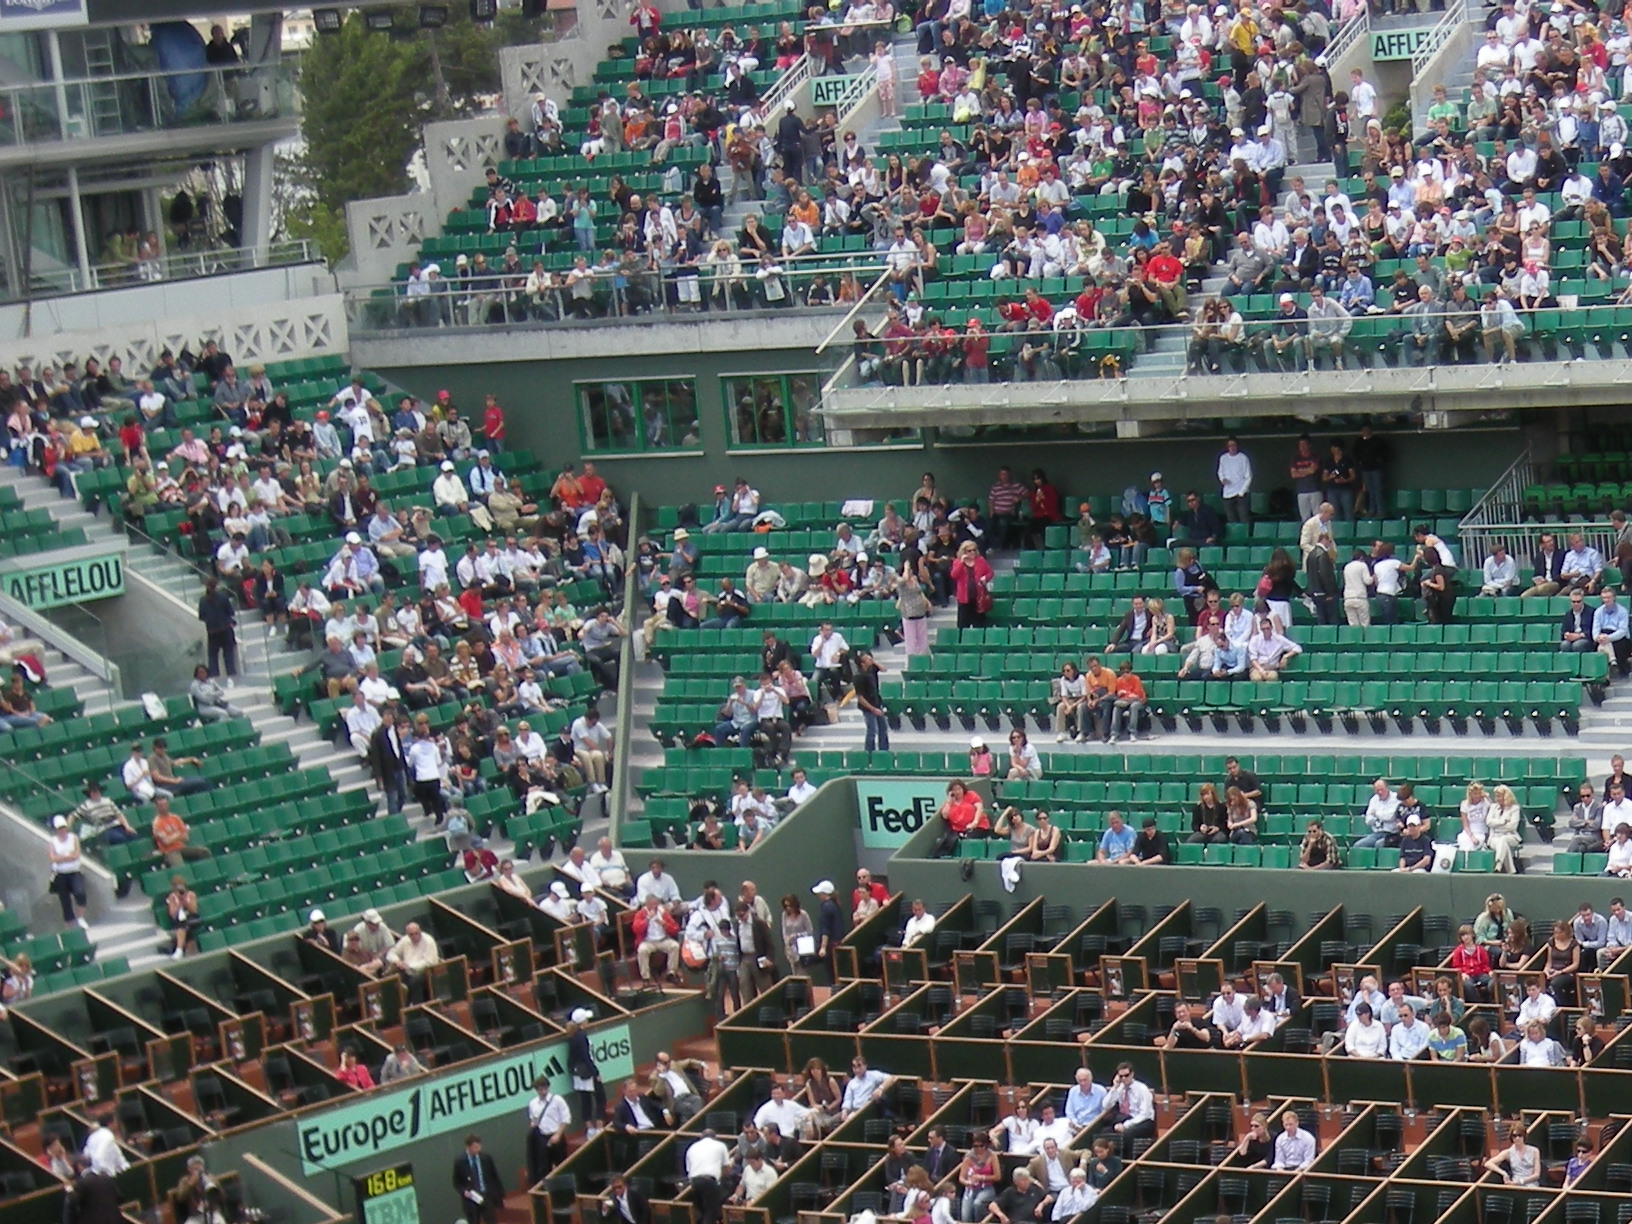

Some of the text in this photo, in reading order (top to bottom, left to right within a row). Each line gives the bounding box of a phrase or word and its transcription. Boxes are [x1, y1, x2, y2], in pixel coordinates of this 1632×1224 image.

[10, 559, 122, 606] AFFLELOU
[867, 796, 937, 834] FedE
[430, 1061, 534, 1120] AFFLELOU
[367, 1168, 396, 1196] 168
